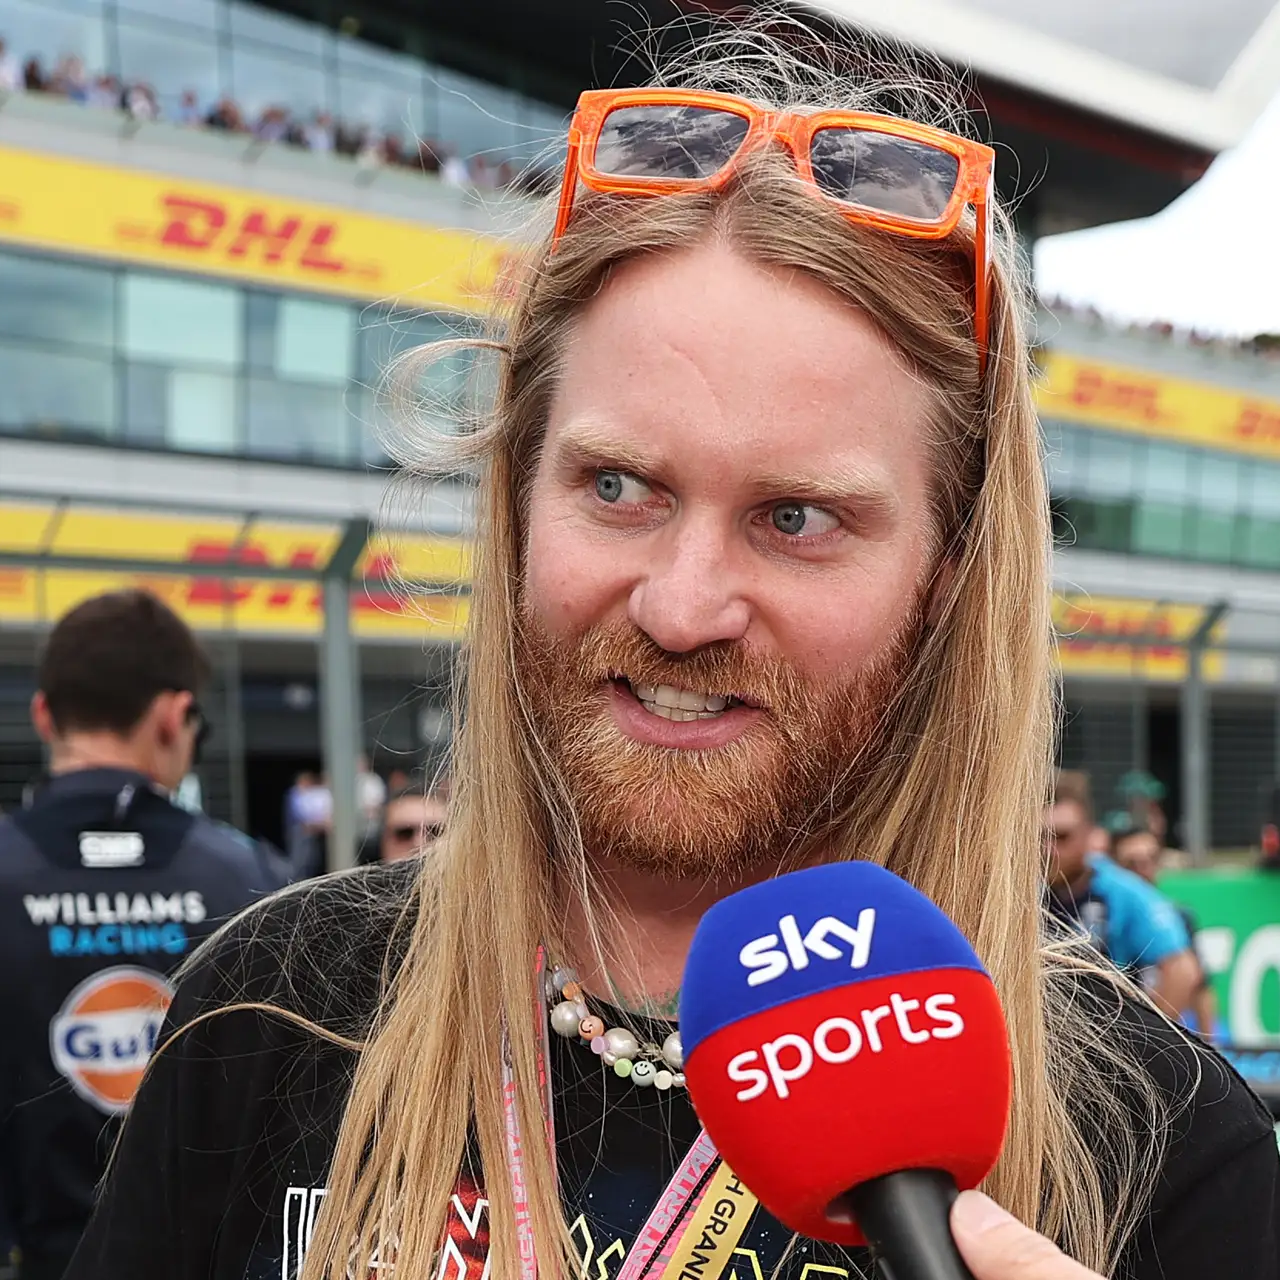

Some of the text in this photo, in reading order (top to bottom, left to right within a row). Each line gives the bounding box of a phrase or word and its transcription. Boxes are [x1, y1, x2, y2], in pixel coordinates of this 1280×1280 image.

[158, 195, 347, 274] DHL
[23, 889, 207, 926] WILLIAMS
[48, 922, 189, 957] RACING
[738, 908, 876, 988] sky
[63, 1022, 157, 1062] Gul
[727, 991, 964, 1102] sports
